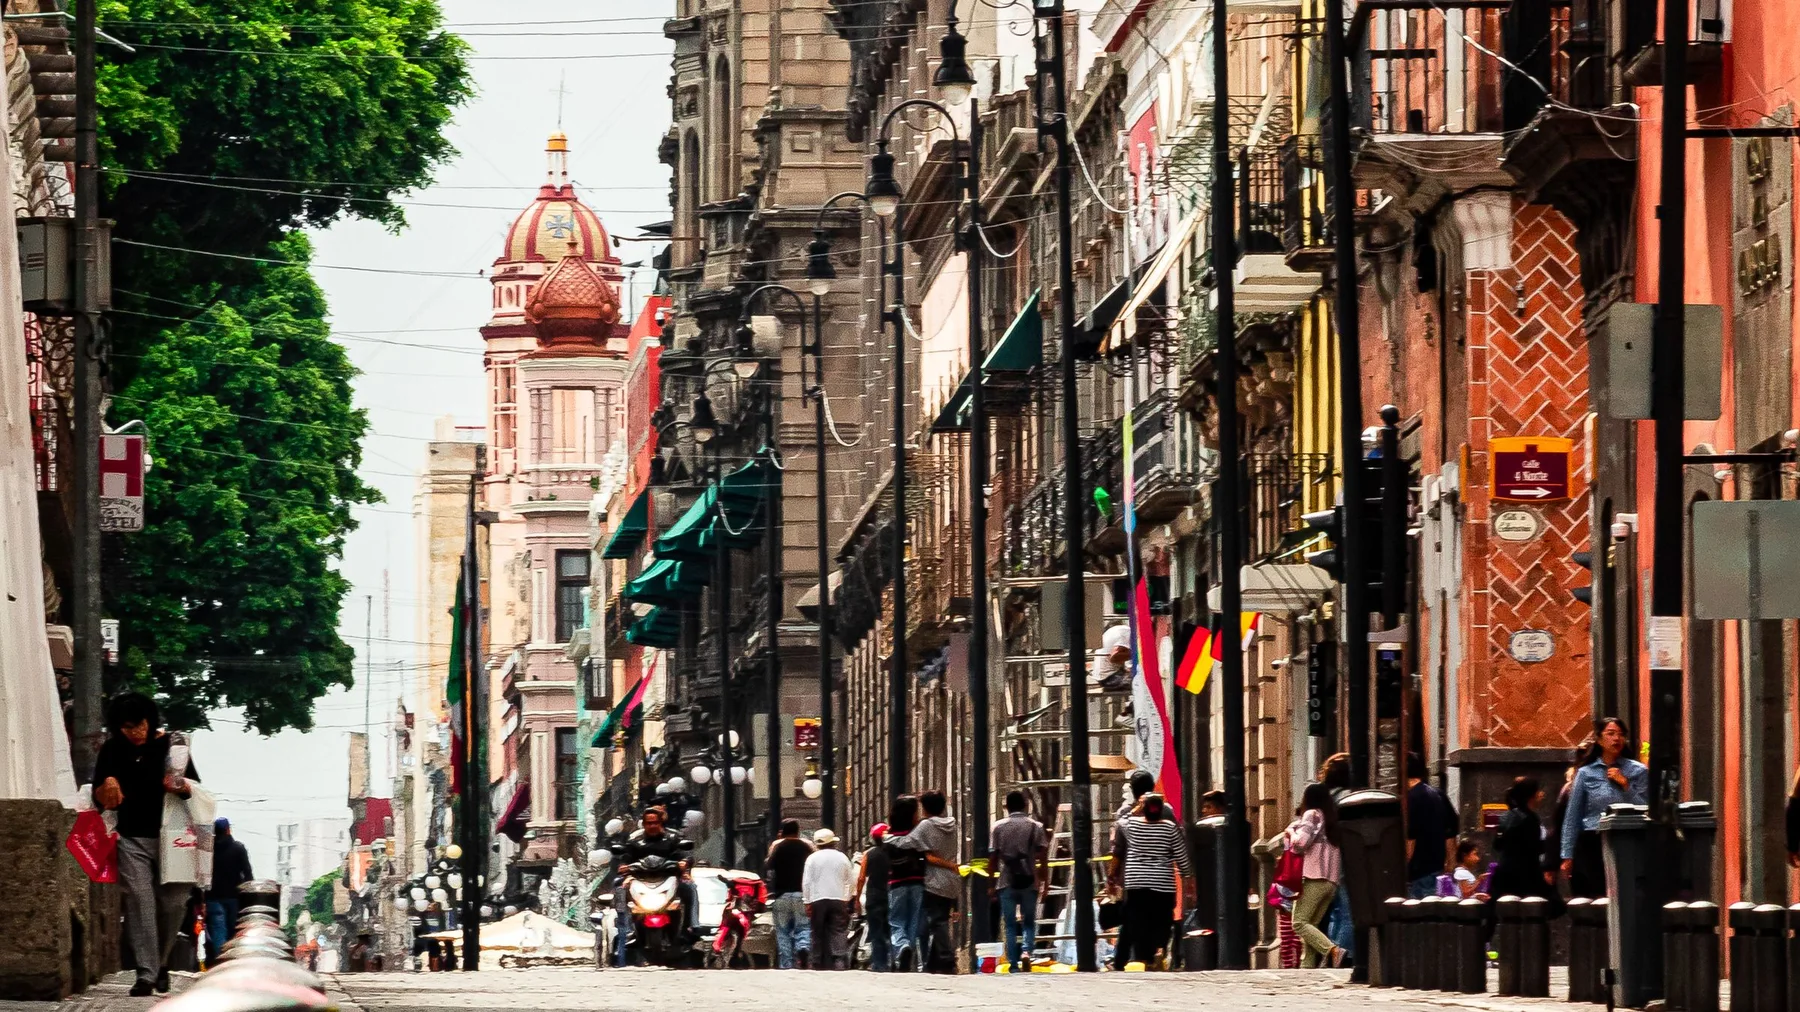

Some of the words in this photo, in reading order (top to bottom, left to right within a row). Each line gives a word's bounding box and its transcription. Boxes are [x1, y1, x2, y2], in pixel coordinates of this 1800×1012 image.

[99, 435, 142, 496] H
[1521, 459, 1541, 469] Calle
[1522, 471, 1549, 482] Norte
[1310, 643, 1321, 721] TATTOO
